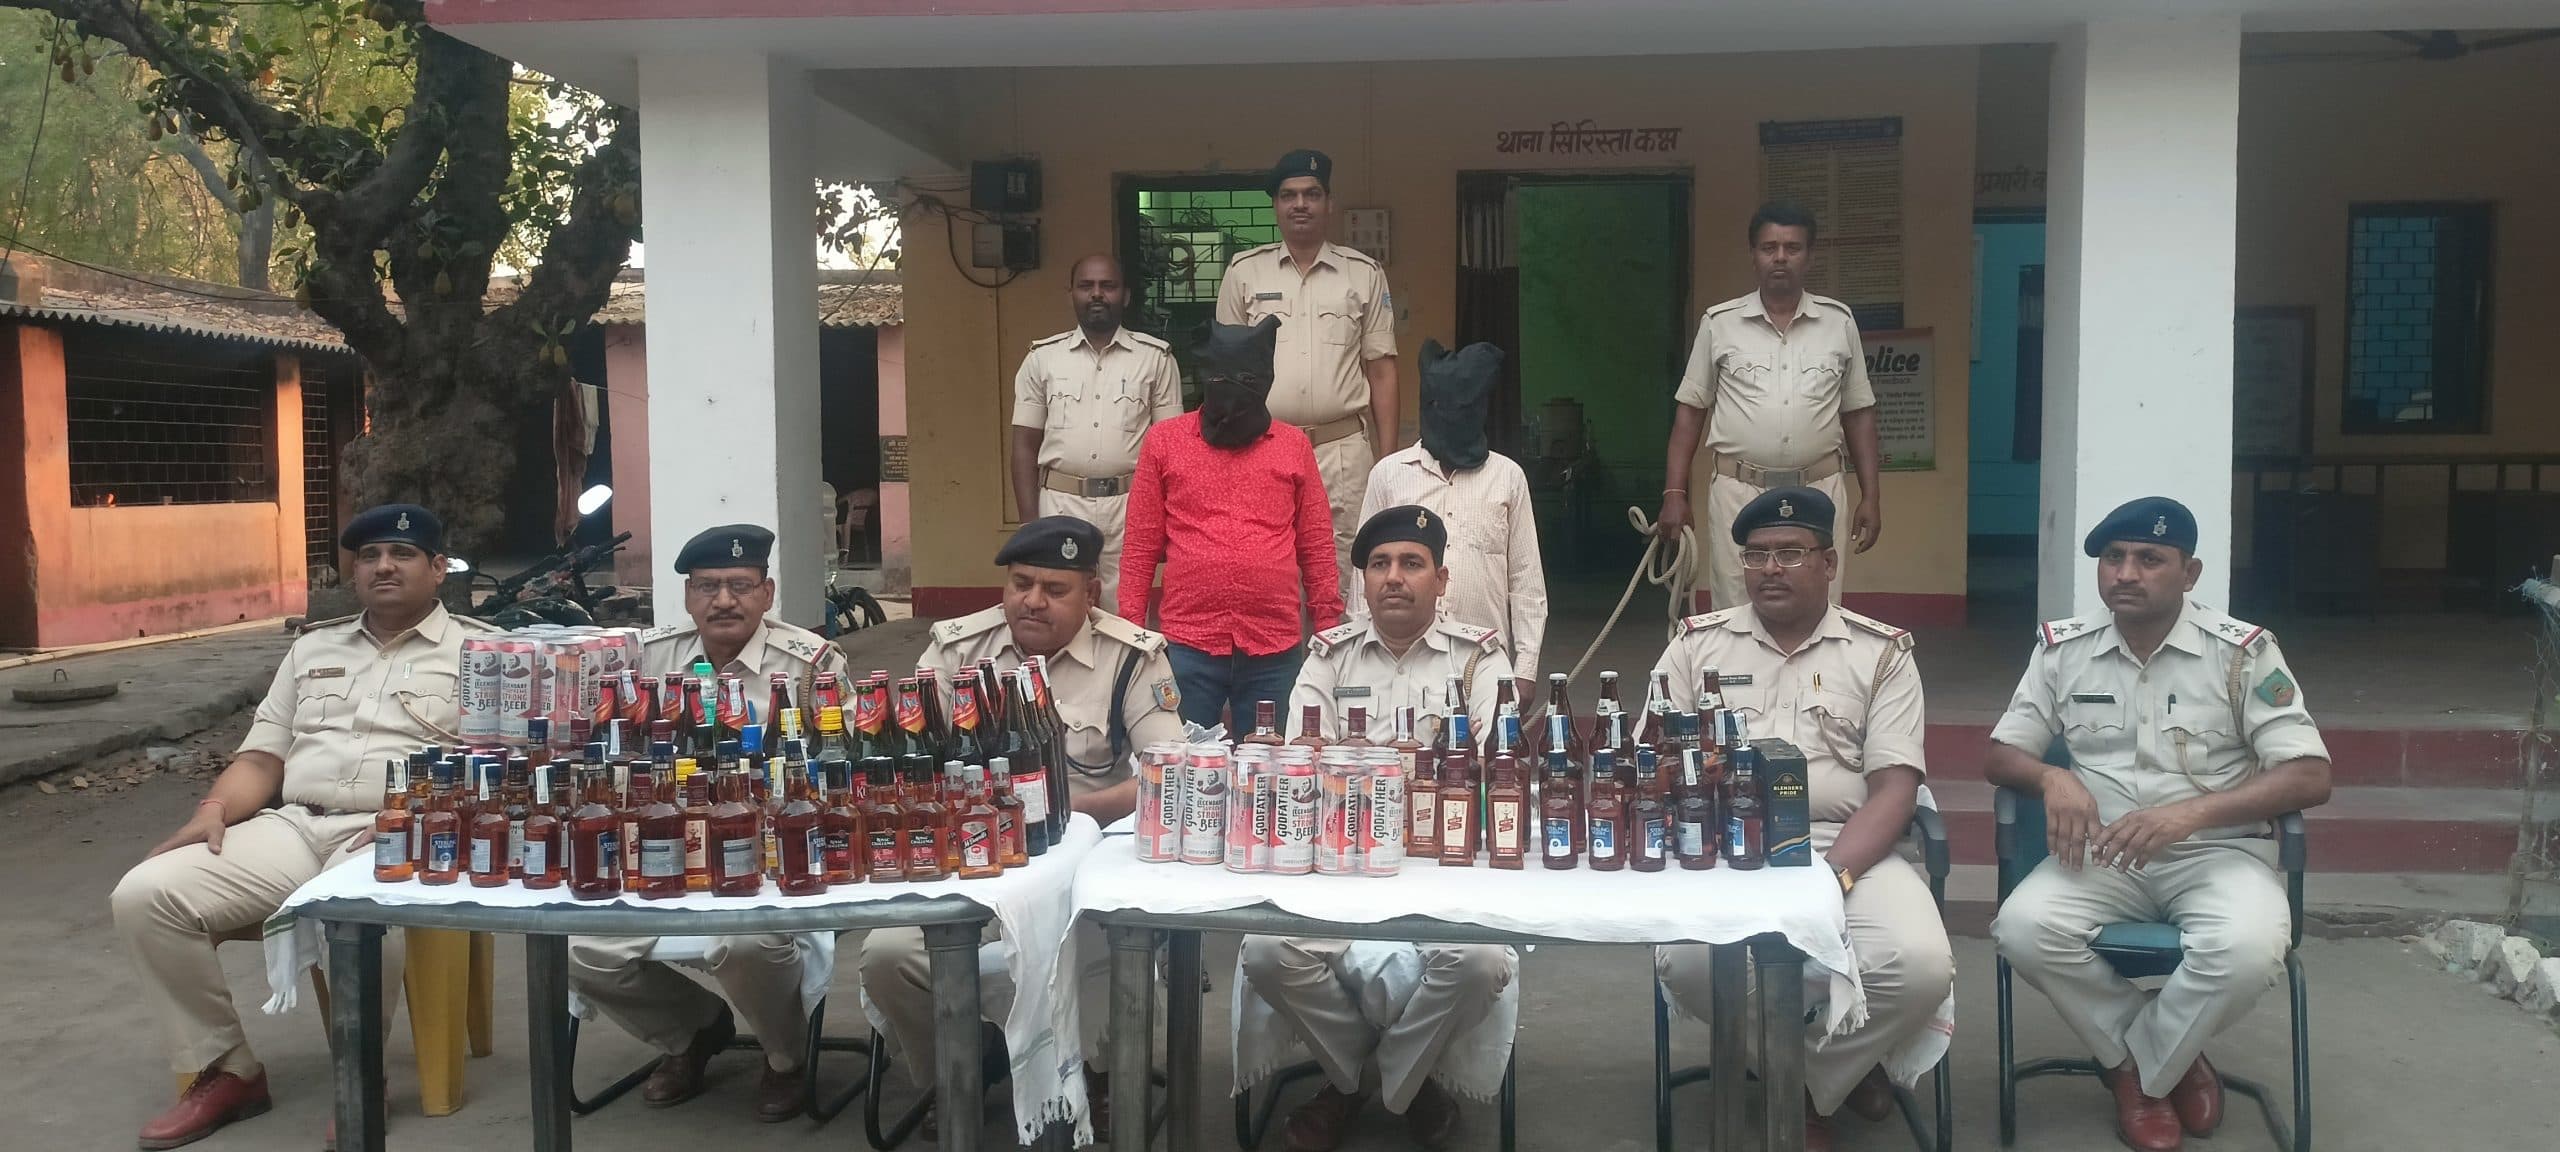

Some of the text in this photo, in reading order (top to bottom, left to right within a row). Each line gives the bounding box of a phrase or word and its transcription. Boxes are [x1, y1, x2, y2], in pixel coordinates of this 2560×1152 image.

[1496, 130, 1545, 153] थाना
[1633, 127, 1682, 153] कक्ष
[1866, 345, 1920, 373] olice
[462, 652, 475, 708] GODFATHER
[477, 698, 497, 711] BEE
[503, 700, 527, 712] BEER
[1163, 767, 1177, 826] GODFATHER
[1185, 767, 1198, 827] GODFATHER
[1256, 775, 1268, 836] GODFATHER
[1277, 778, 1292, 838] GODFATHER
[1347, 777, 1359, 838] GODFATHER
[1373, 778, 1389, 839] GODFATHER
